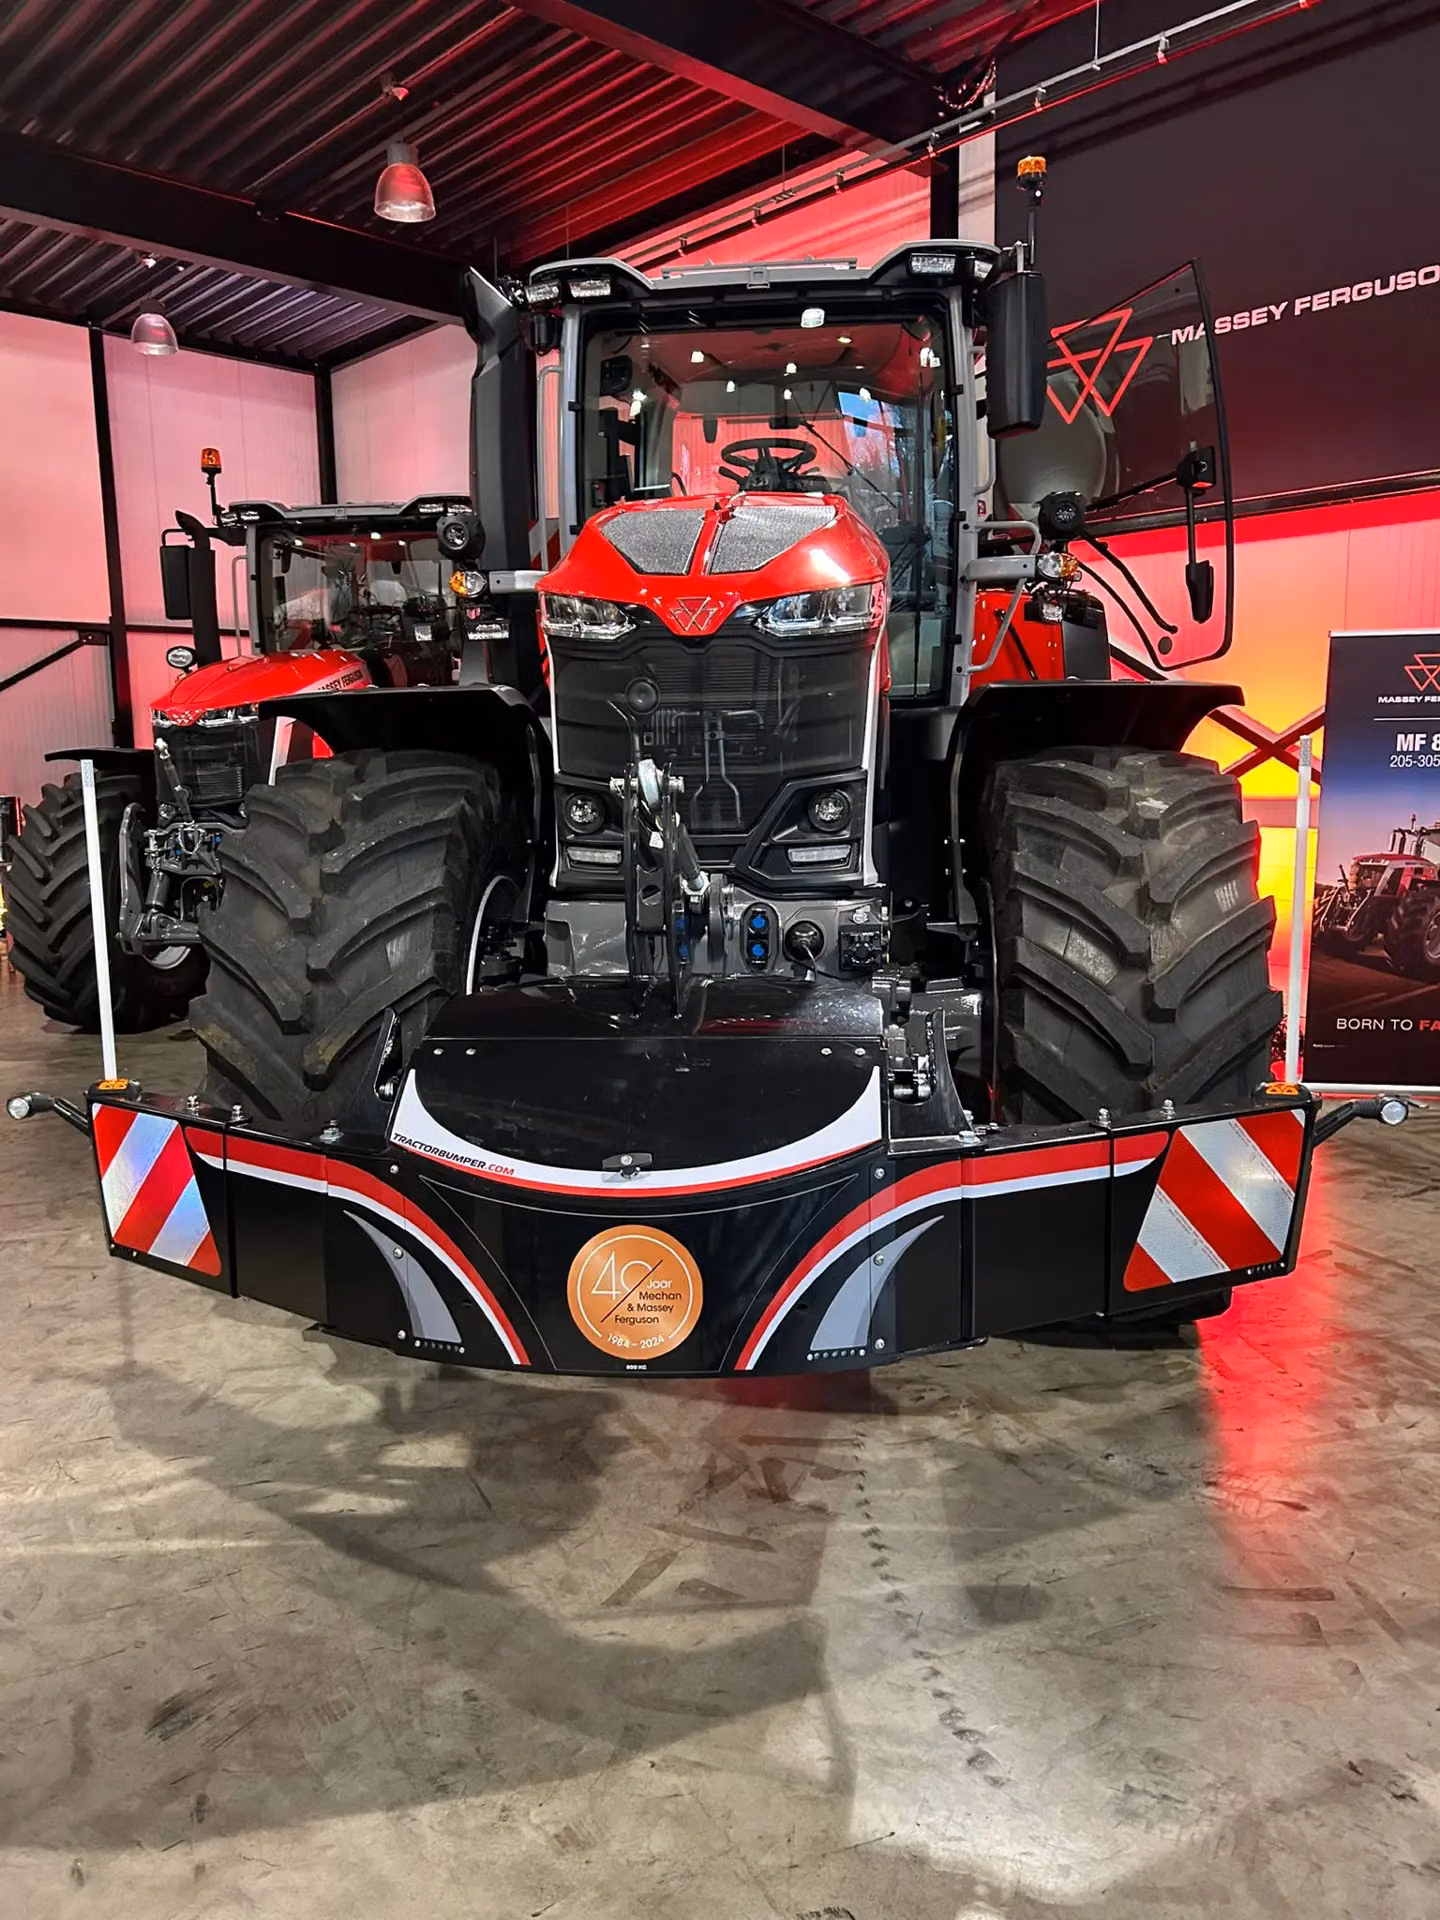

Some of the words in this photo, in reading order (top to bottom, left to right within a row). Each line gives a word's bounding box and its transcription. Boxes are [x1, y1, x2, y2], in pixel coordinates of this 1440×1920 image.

[1294, 264, 1440, 316] FERGUSO
[1377, 695, 1423, 704] MASSEY
[1396, 733, 1427, 752] MF
[1389, 754, 1440, 768] 205-305
[1336, 1018, 1385, 1030] BORN
[1390, 1018, 1413, 1031] TO
[393, 1132, 515, 1176] TRACTORBUMPER.COM
[591, 1250, 653, 1300] 40
[646, 1279, 673, 1289] Jaar
[638, 1291, 682, 1301] Mechan
[626, 1303, 634, 1312] &
[636, 1303, 674, 1314] Massey
[614, 1314, 660, 1326] Ferguson
[608, 1332, 630, 1348] 1984
[640, 1334, 665, 1349] 2024
